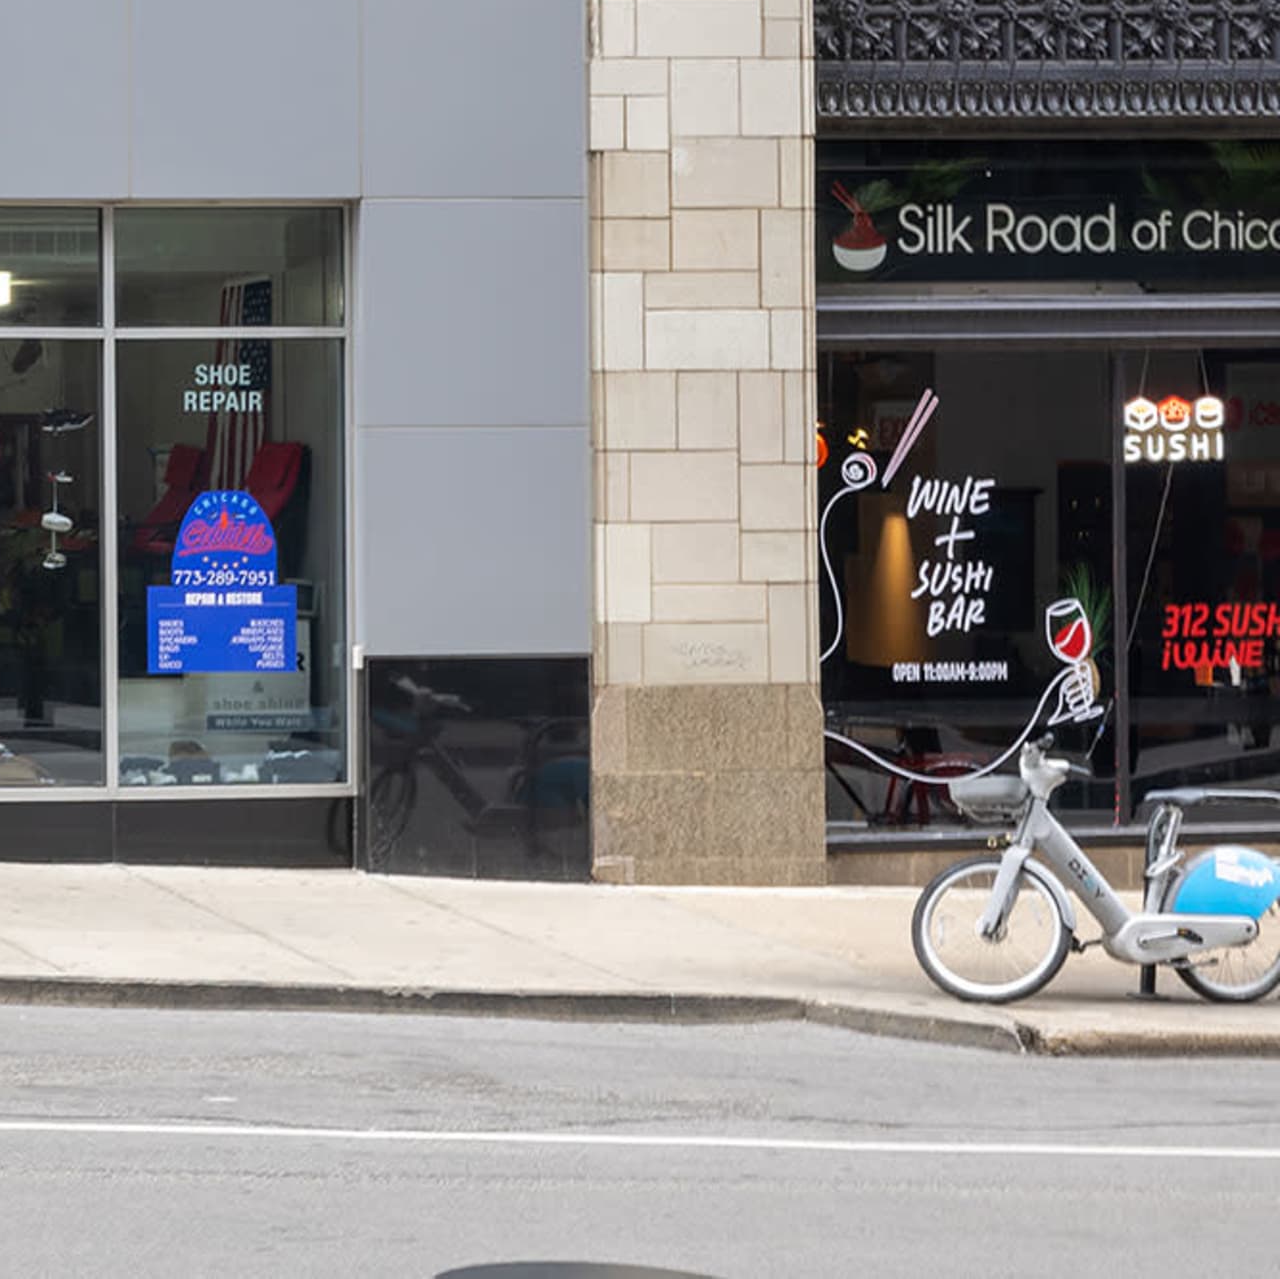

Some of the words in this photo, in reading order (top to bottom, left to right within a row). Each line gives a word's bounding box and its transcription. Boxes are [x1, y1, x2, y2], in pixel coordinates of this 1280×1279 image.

[898, 204, 973, 253] Silk
[986, 204, 1116, 253] Road
[1131, 210, 1172, 251] of
[195, 365, 251, 386] SHOE
[183, 391, 262, 412] REPAIR
[1124, 432, 1224, 462] SUSHI
[907, 475, 996, 519] WINE
[174, 570, 275, 586] 773-289-7951
[910, 560, 993, 599] SUSHI
[926, 594, 986, 637] BAR
[1162, 603, 1210, 638] 312
[893, 662, 920, 681] OPEN
